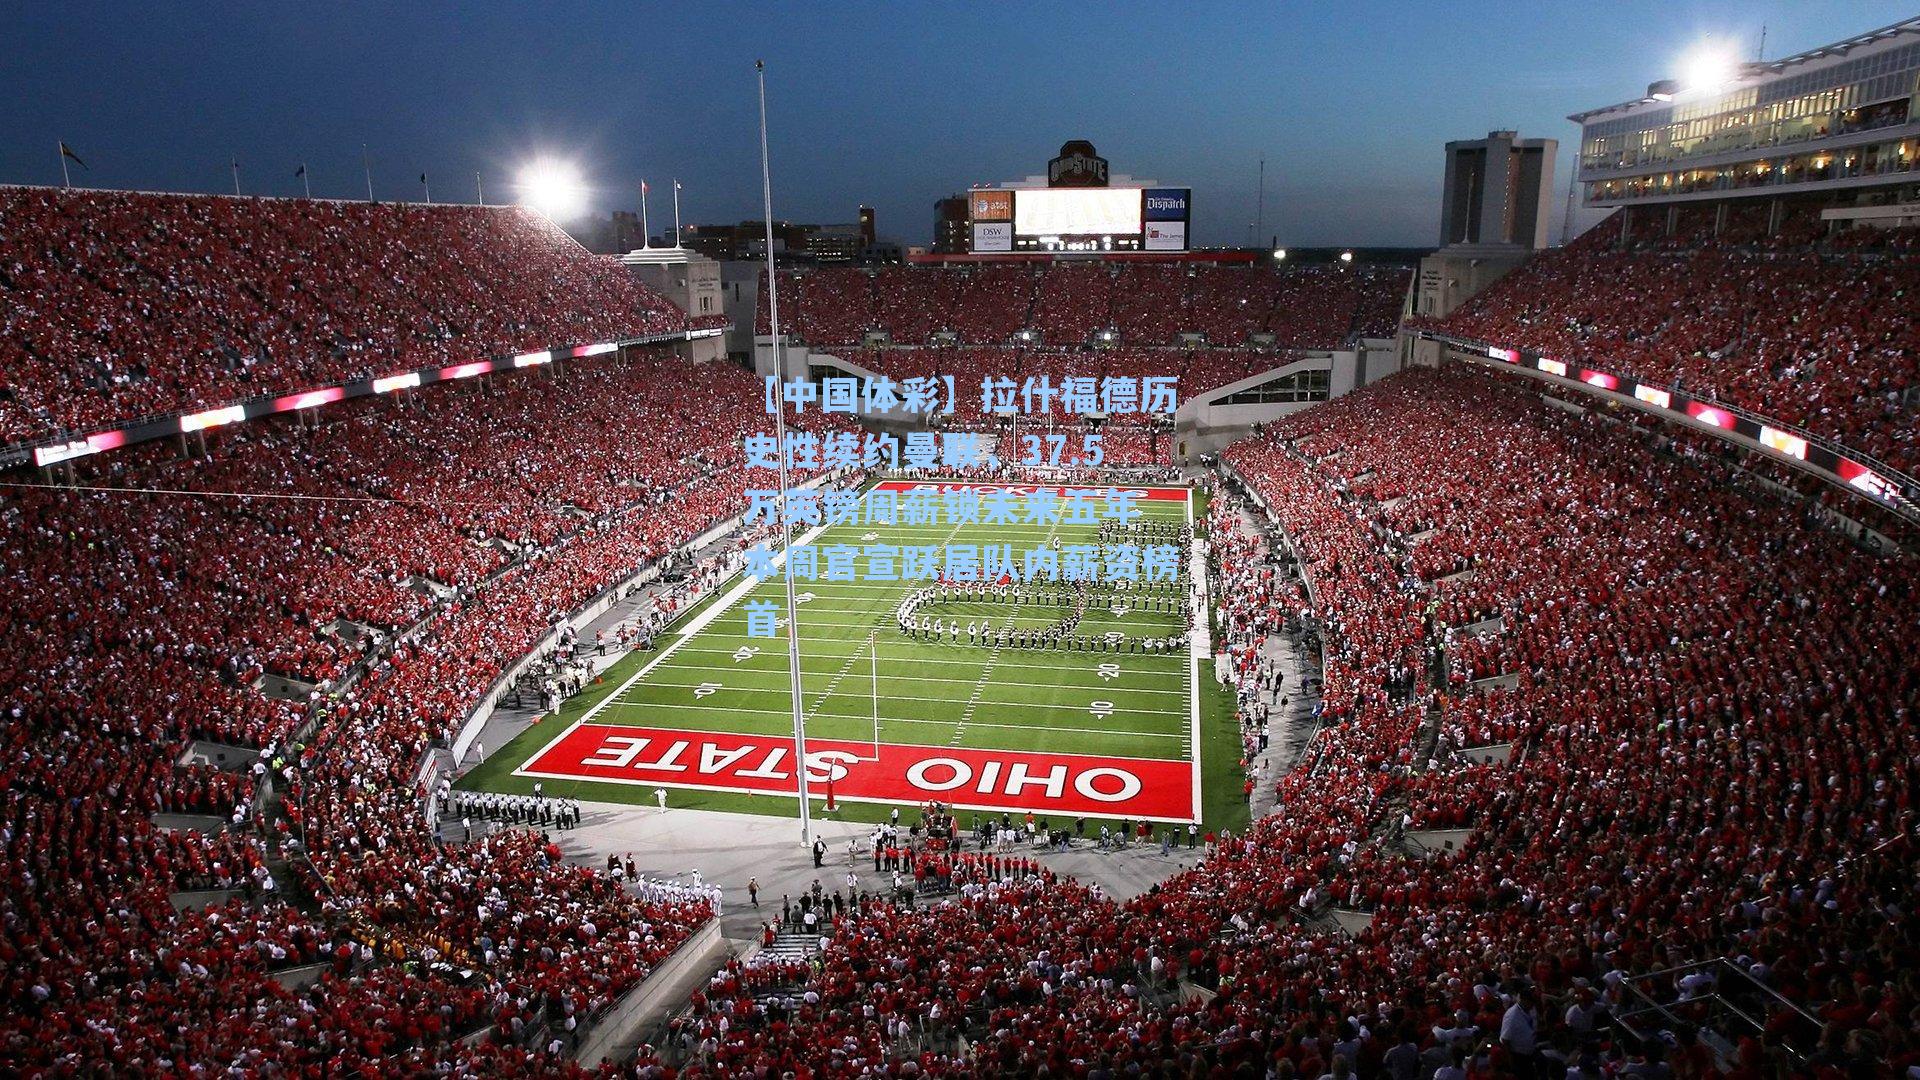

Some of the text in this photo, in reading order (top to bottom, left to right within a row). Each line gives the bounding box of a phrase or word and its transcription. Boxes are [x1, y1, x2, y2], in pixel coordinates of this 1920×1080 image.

[1147, 197, 1185, 211] Dispatch
[983, 228, 1002, 236] DSW
[913, 484, 1149, 498] BUCKEES
[1097, 663, 1121, 678] 20
[693, 682, 723, 695] 10
[1088, 700, 1114, 715] 10
[580, 736, 1143, 804] OHIO STATE
